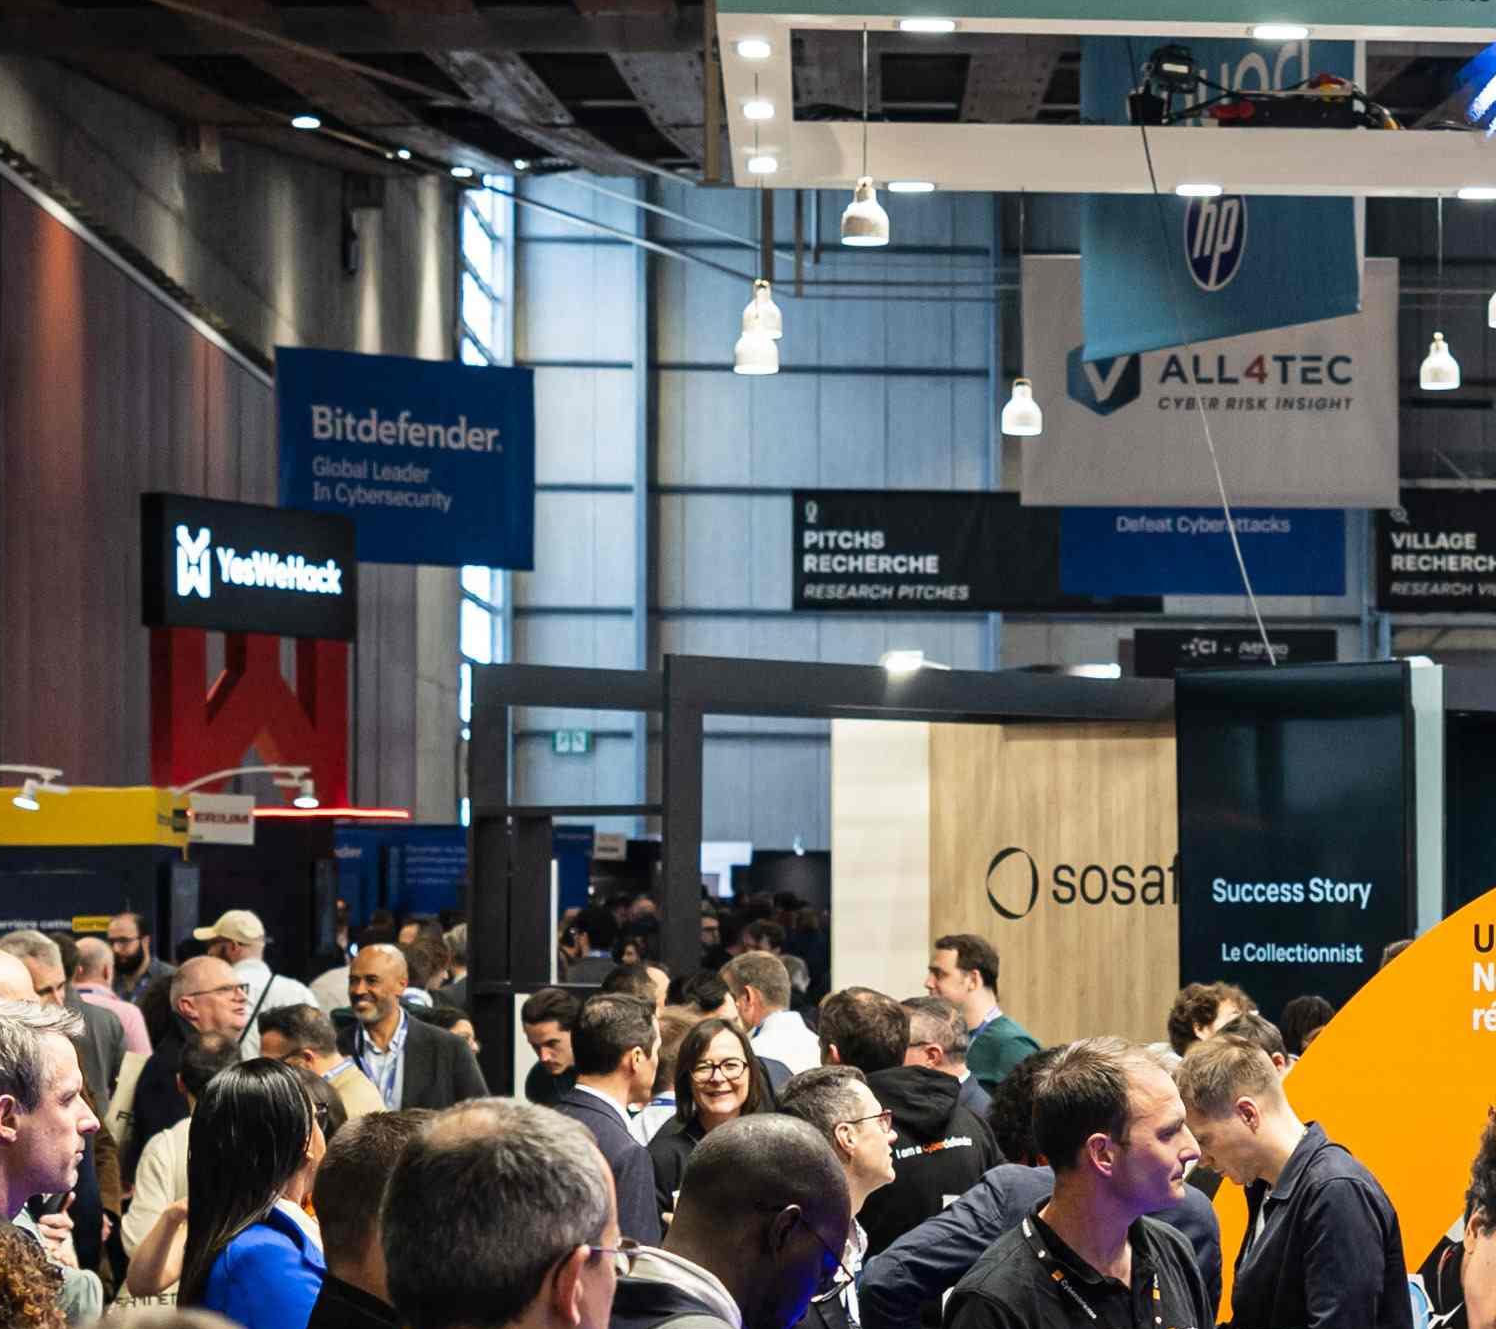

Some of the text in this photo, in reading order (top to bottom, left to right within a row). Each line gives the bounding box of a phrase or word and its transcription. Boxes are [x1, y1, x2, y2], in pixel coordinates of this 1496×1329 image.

[1158, 353, 1353, 386] ALL4TEC
[1157, 395, 1353, 412] CYBER RISK INSIGHT
[311, 456, 431, 484] Global Leader
[313, 480, 453, 514] In Cybersecurity
[1116, 515, 1291, 537] Defeat Cyberattacks
[803, 530, 885, 550] PITCHS
[1391, 532, 1477, 550] VILLAGE
[216, 546, 342, 595] YesWeHack
[803, 553, 939, 574] RECHERCHE
[803, 583, 969, 601] RESEARCH PITCHES
[1390, 581, 1474, 596] RESEARCH
[1051, 853, 1180, 906] sosaf
[1212, 877, 1372, 910] Success Story
[1221, 942, 1364, 963] Le Collectionnist
